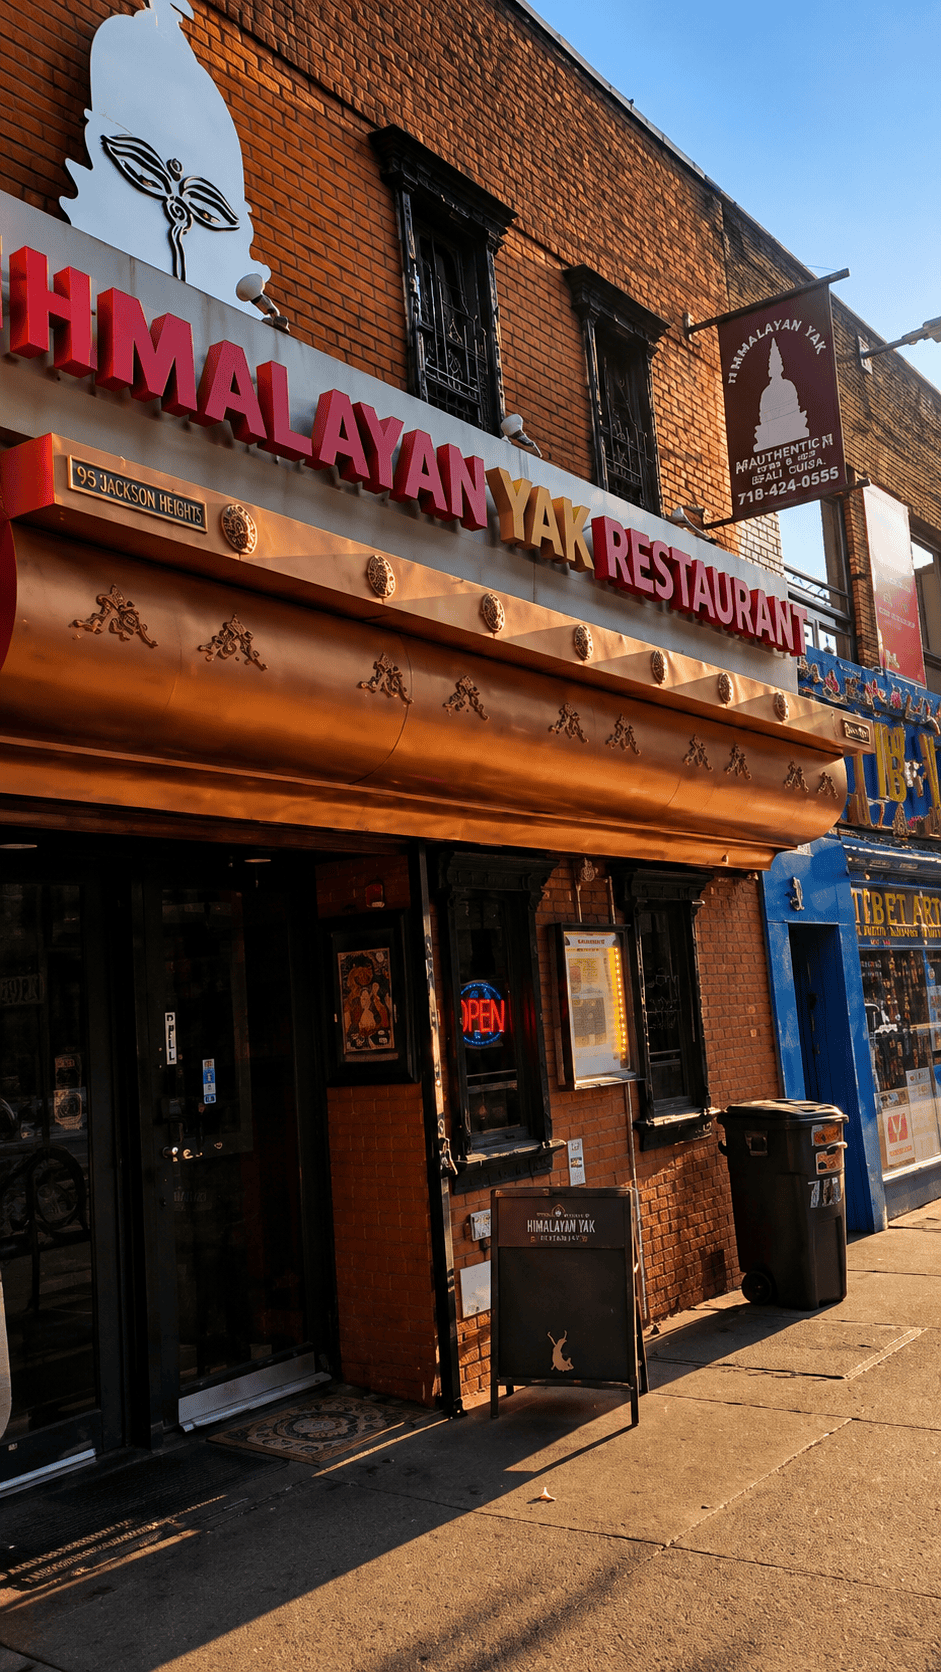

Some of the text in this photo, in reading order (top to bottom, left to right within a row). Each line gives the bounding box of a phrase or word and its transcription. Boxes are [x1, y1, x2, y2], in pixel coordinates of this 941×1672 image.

[805, 325, 826, 355] YAK
[0, 245, 808, 656] HMALAYAN YAK RESTAURANT
[738, 466, 840, 506] 718-424-0555
[159, 493, 202, 524] HEIGHTS
[527, 1219, 596, 1233] HIMALAYAN YAK
